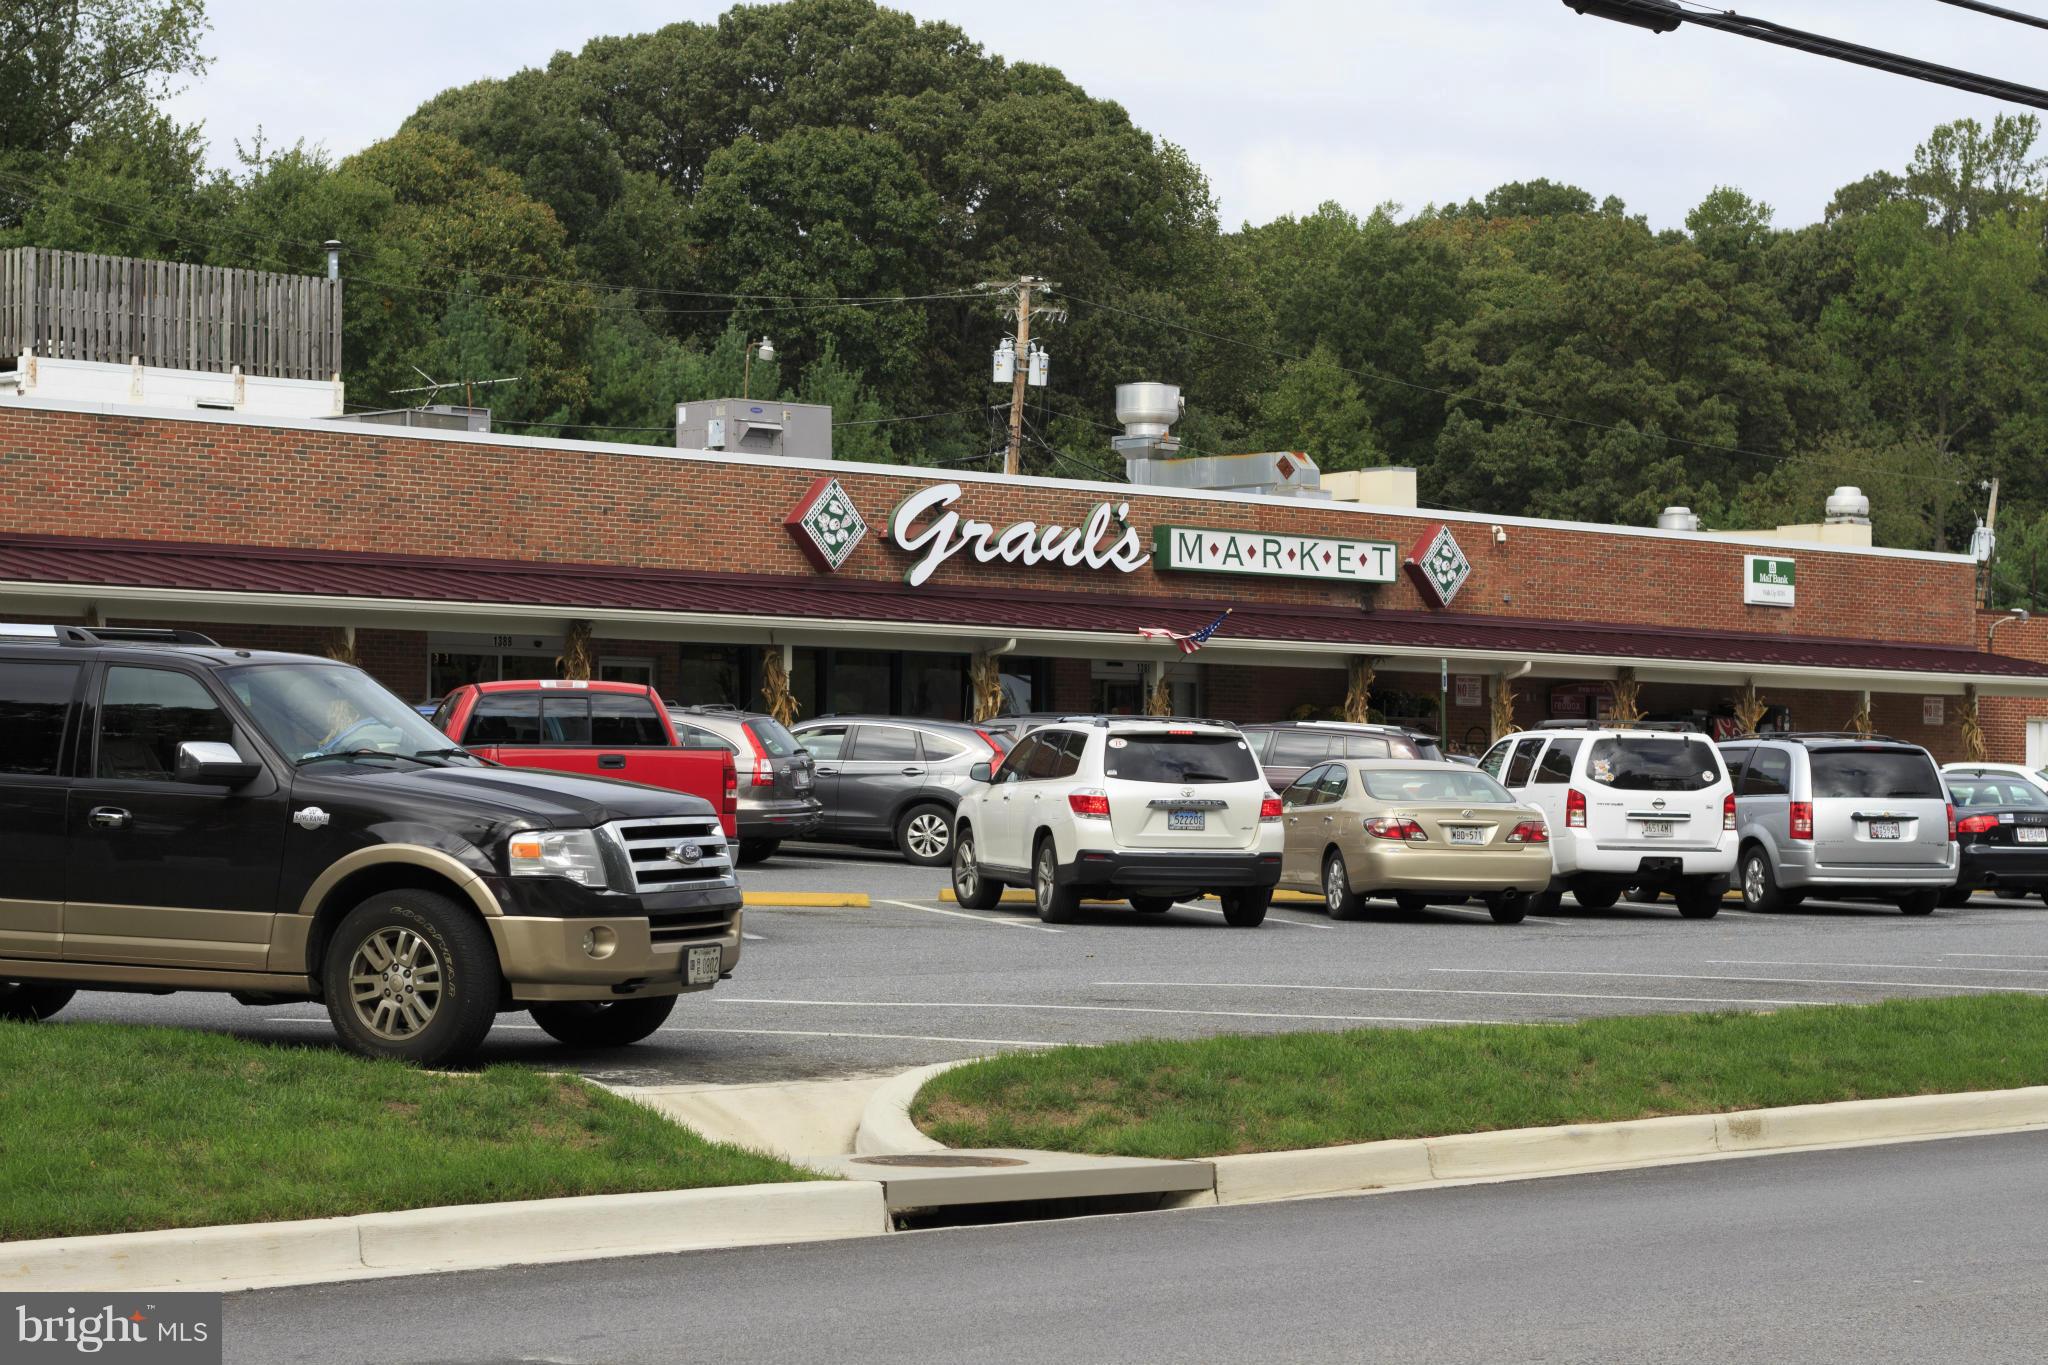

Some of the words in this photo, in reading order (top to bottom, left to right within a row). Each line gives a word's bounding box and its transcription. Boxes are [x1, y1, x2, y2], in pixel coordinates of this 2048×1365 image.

[893, 483, 1150, 586] Graul's
[1178, 532, 1391, 576] MARKET
[1772, 574, 1789, 585] Bank
[1457, 683, 1468, 697] NO
[389, 905, 457, 1000] GOODYEAR
